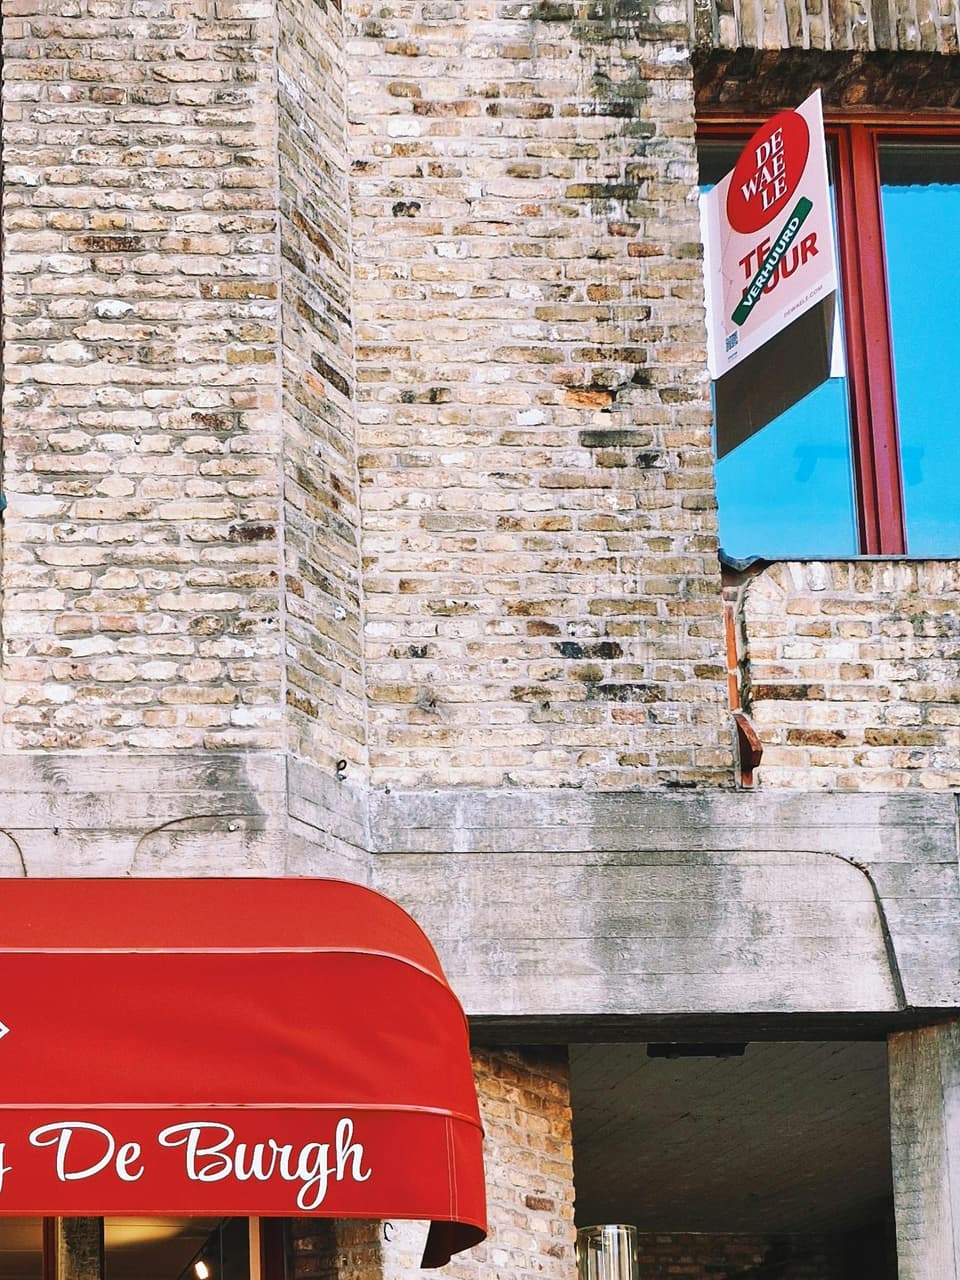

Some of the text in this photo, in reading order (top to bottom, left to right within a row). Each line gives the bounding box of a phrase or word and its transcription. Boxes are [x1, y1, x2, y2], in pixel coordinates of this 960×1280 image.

[756, 128, 784, 169] DE
[741, 150, 786, 202] WAE
[762, 172, 788, 212] LE
[742, 217, 800, 306] VERHUURD
[29, 1121, 144, 1182] De
[158, 1117, 372, 1210] Burgh
